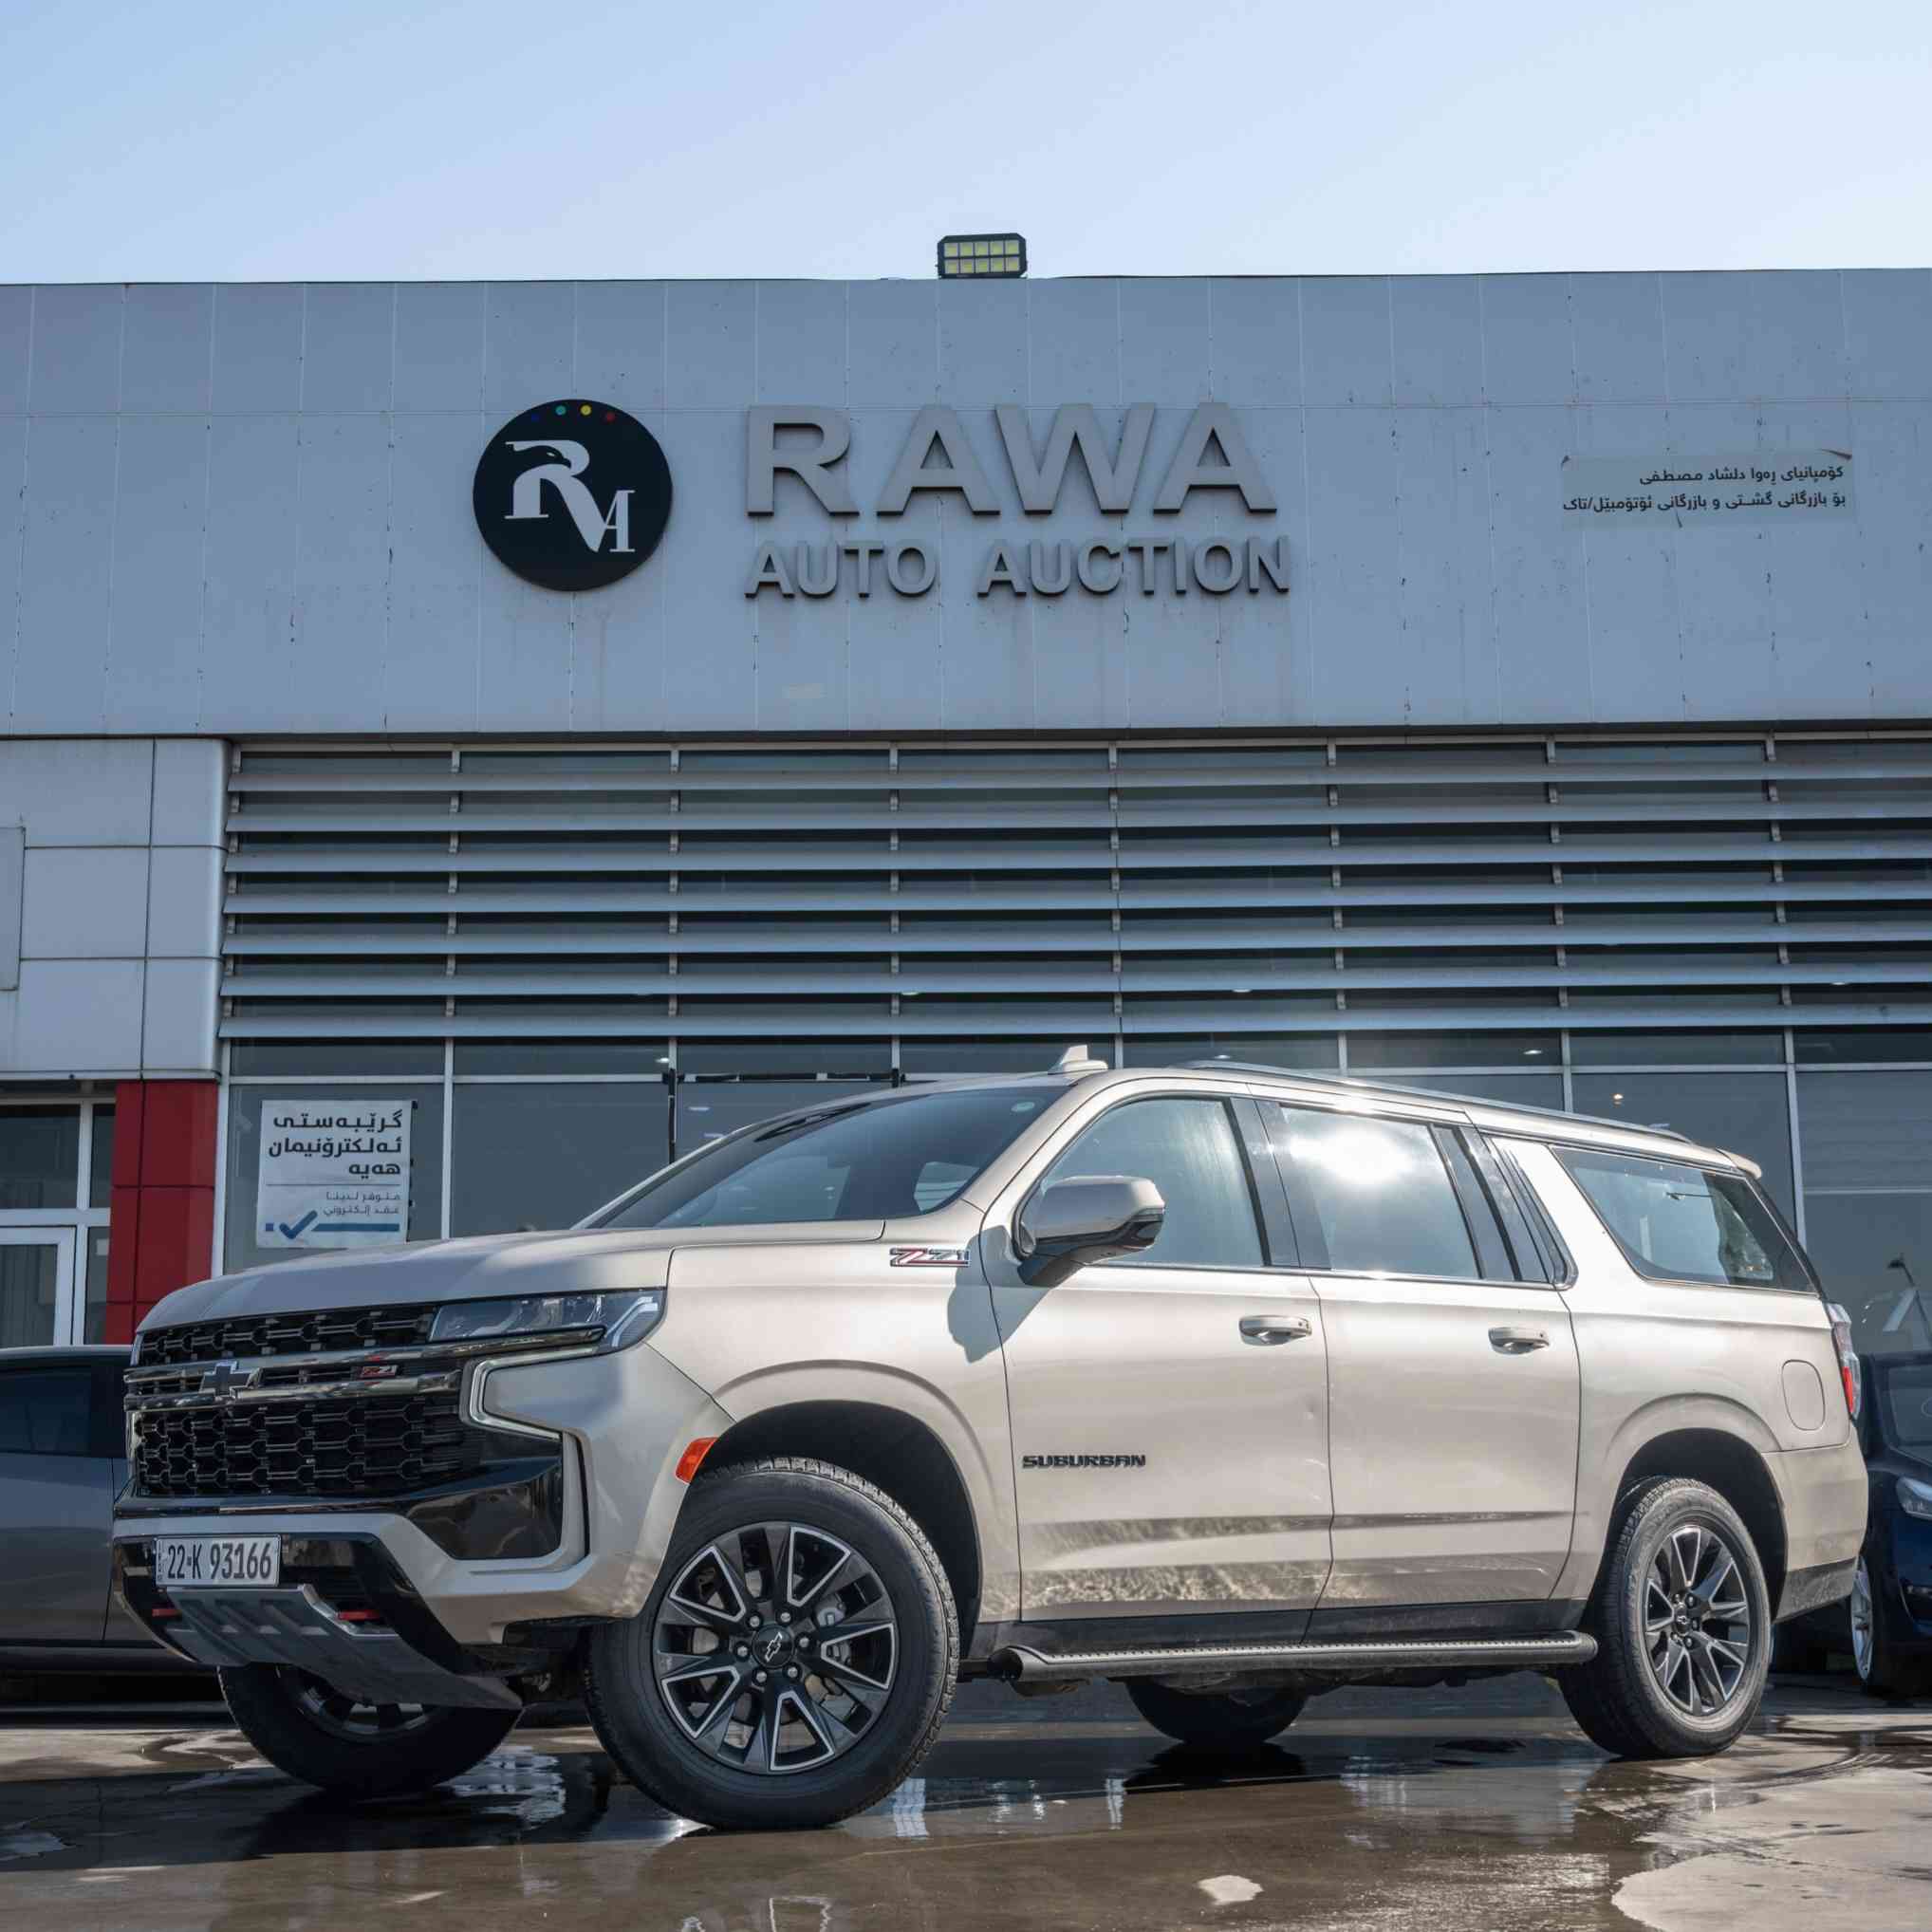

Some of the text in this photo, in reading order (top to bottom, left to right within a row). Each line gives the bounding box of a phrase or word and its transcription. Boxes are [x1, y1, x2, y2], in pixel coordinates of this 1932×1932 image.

[747, 402, 1277, 517] RAWA
[1708, 466, 1746, 481] دلشاد
[1712, 497, 1720, 510] و
[745, 535, 1289, 599] AUTO AUCTION
[1022, 1454, 1146, 1469] SUBURBAN
[210, 1542, 272, 1579] 93166
